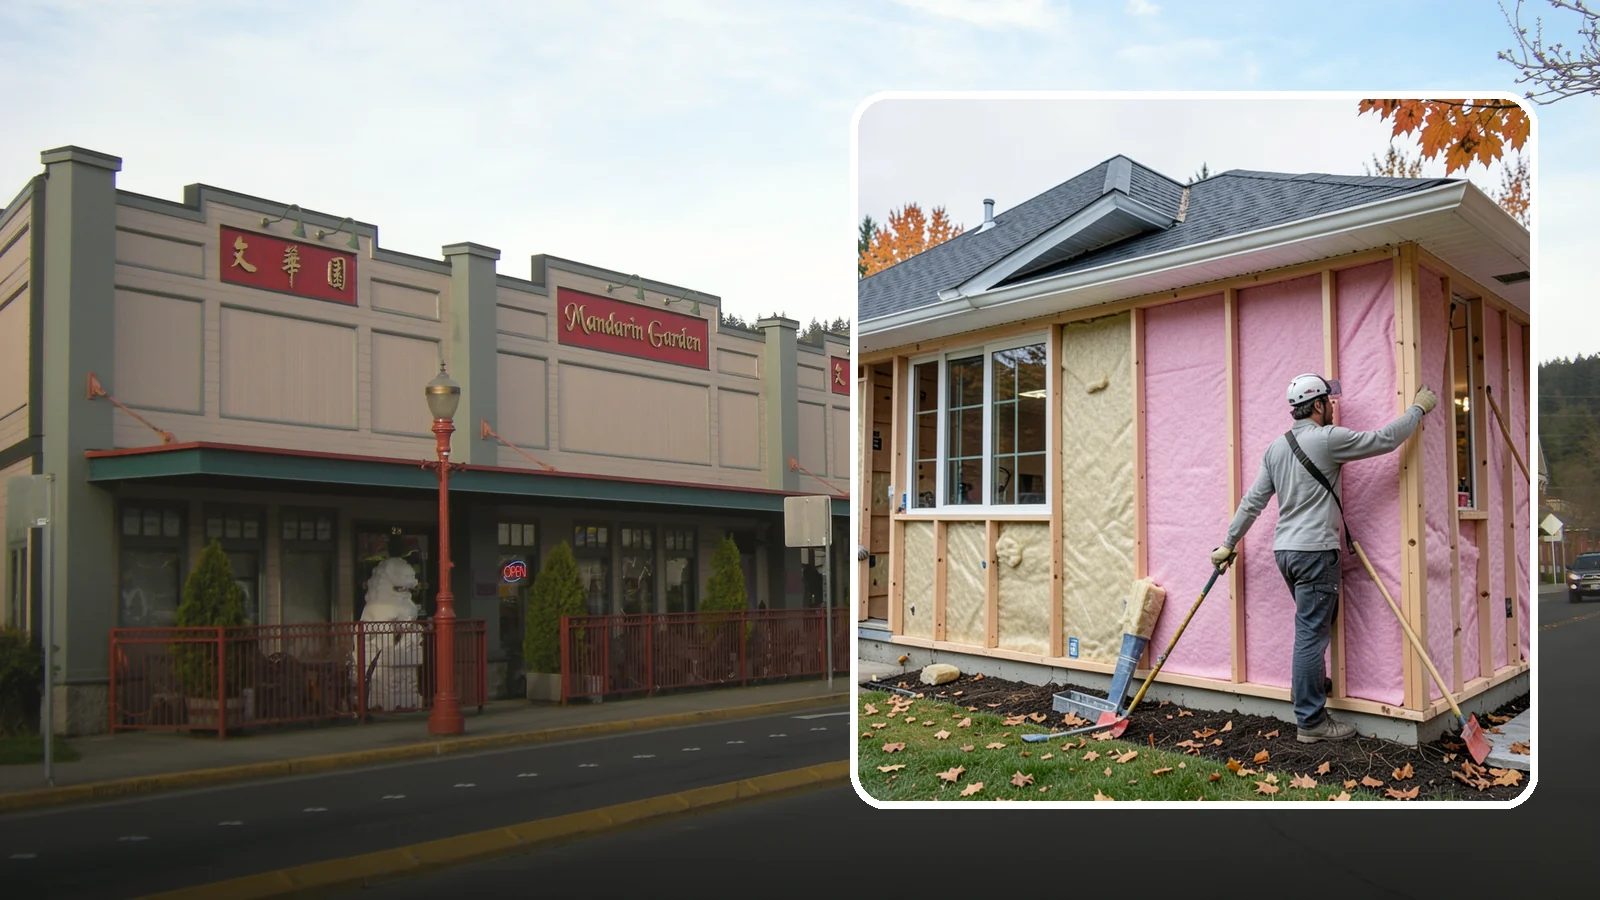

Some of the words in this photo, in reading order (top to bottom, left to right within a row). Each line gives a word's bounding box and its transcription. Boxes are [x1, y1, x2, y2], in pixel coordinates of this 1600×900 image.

[231, 235, 347, 291] 文華園
[564, 302, 644, 341] Mandarin
[648, 320, 701, 352] Garden
[834, 363, 847, 386] 文
[503, 565, 527, 578] OPEN
